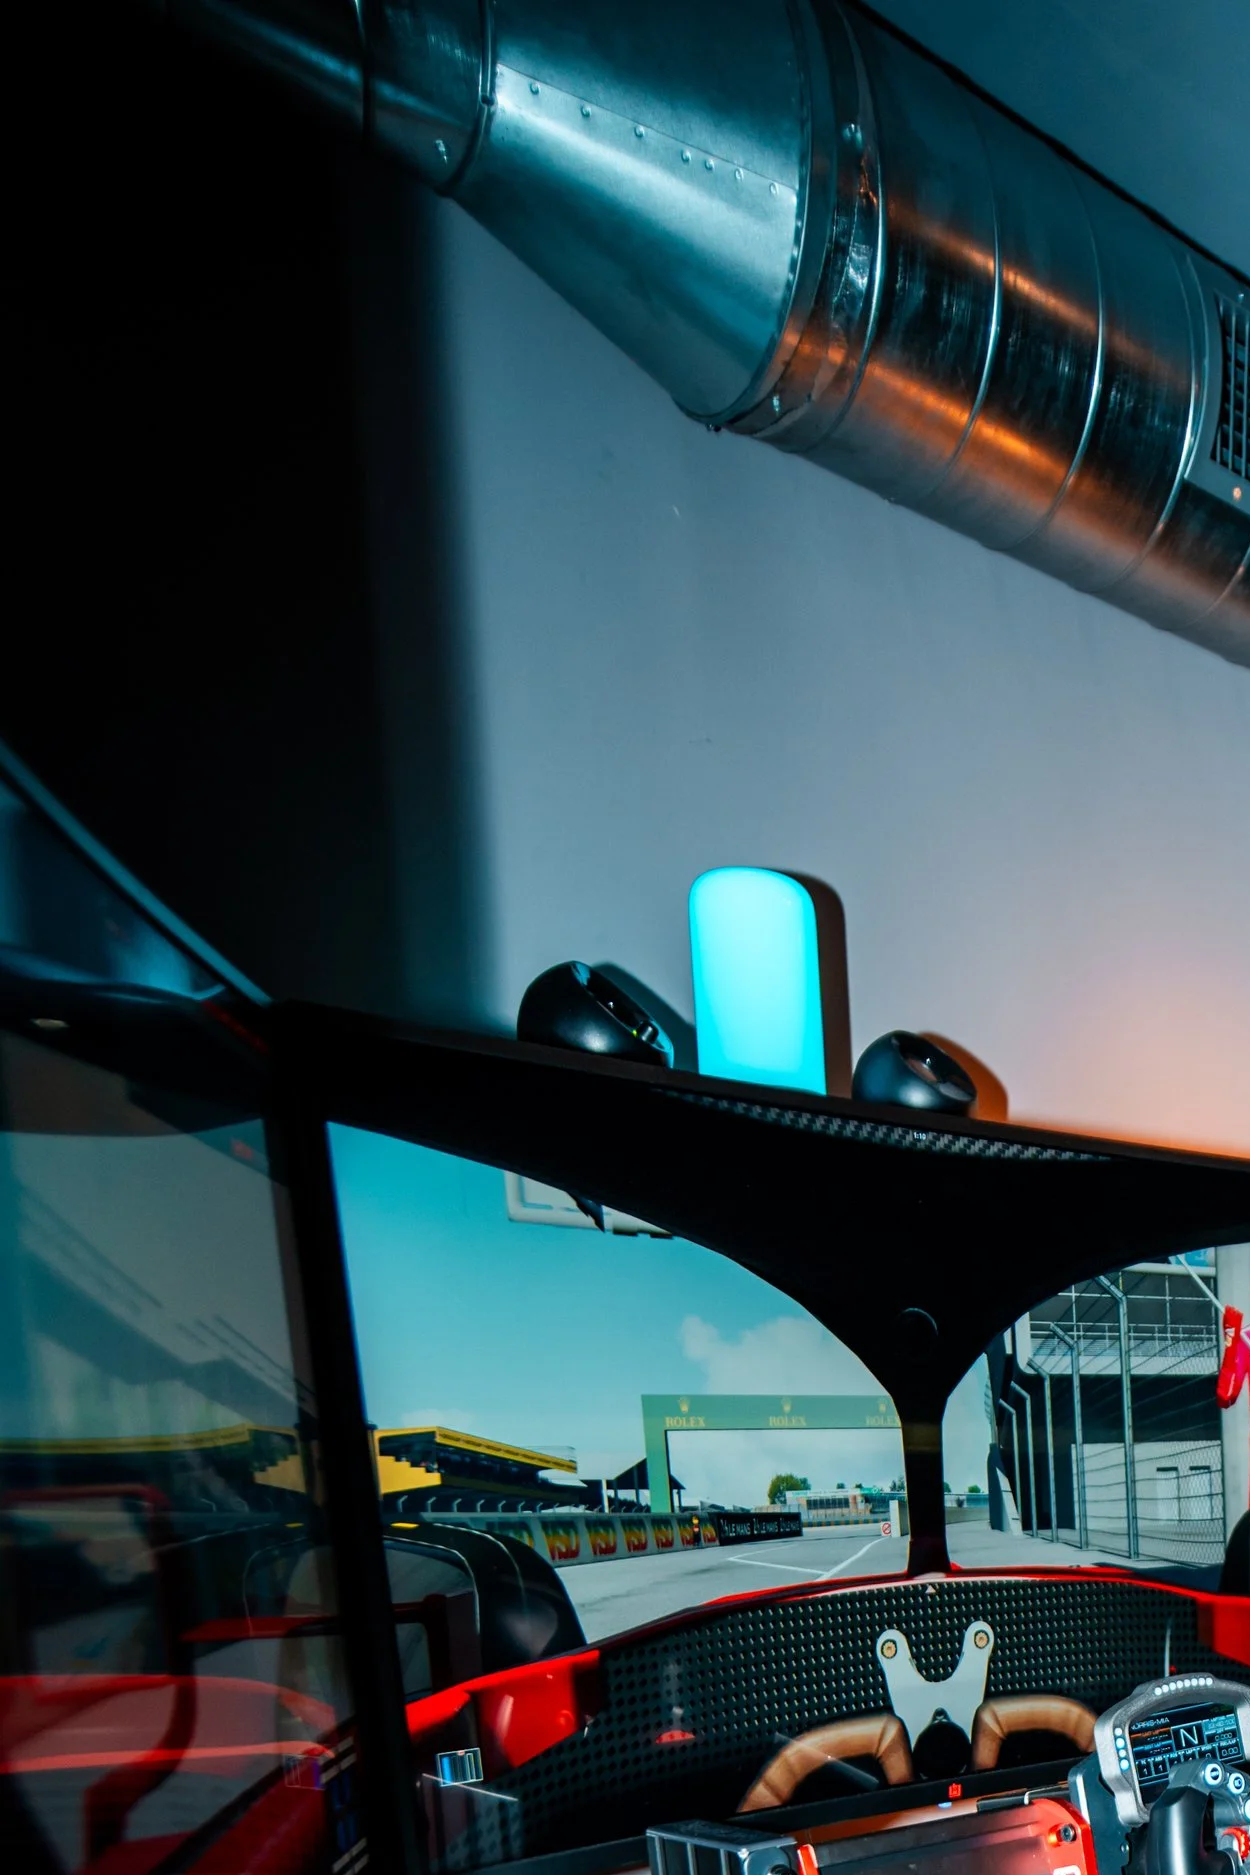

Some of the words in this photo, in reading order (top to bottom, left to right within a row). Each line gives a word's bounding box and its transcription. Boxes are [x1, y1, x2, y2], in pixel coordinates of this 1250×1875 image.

[665, 1416, 706, 1428] ROLEX
[769, 1416, 807, 1427] ROLEX
[1180, 1726, 1199, 1748] N
